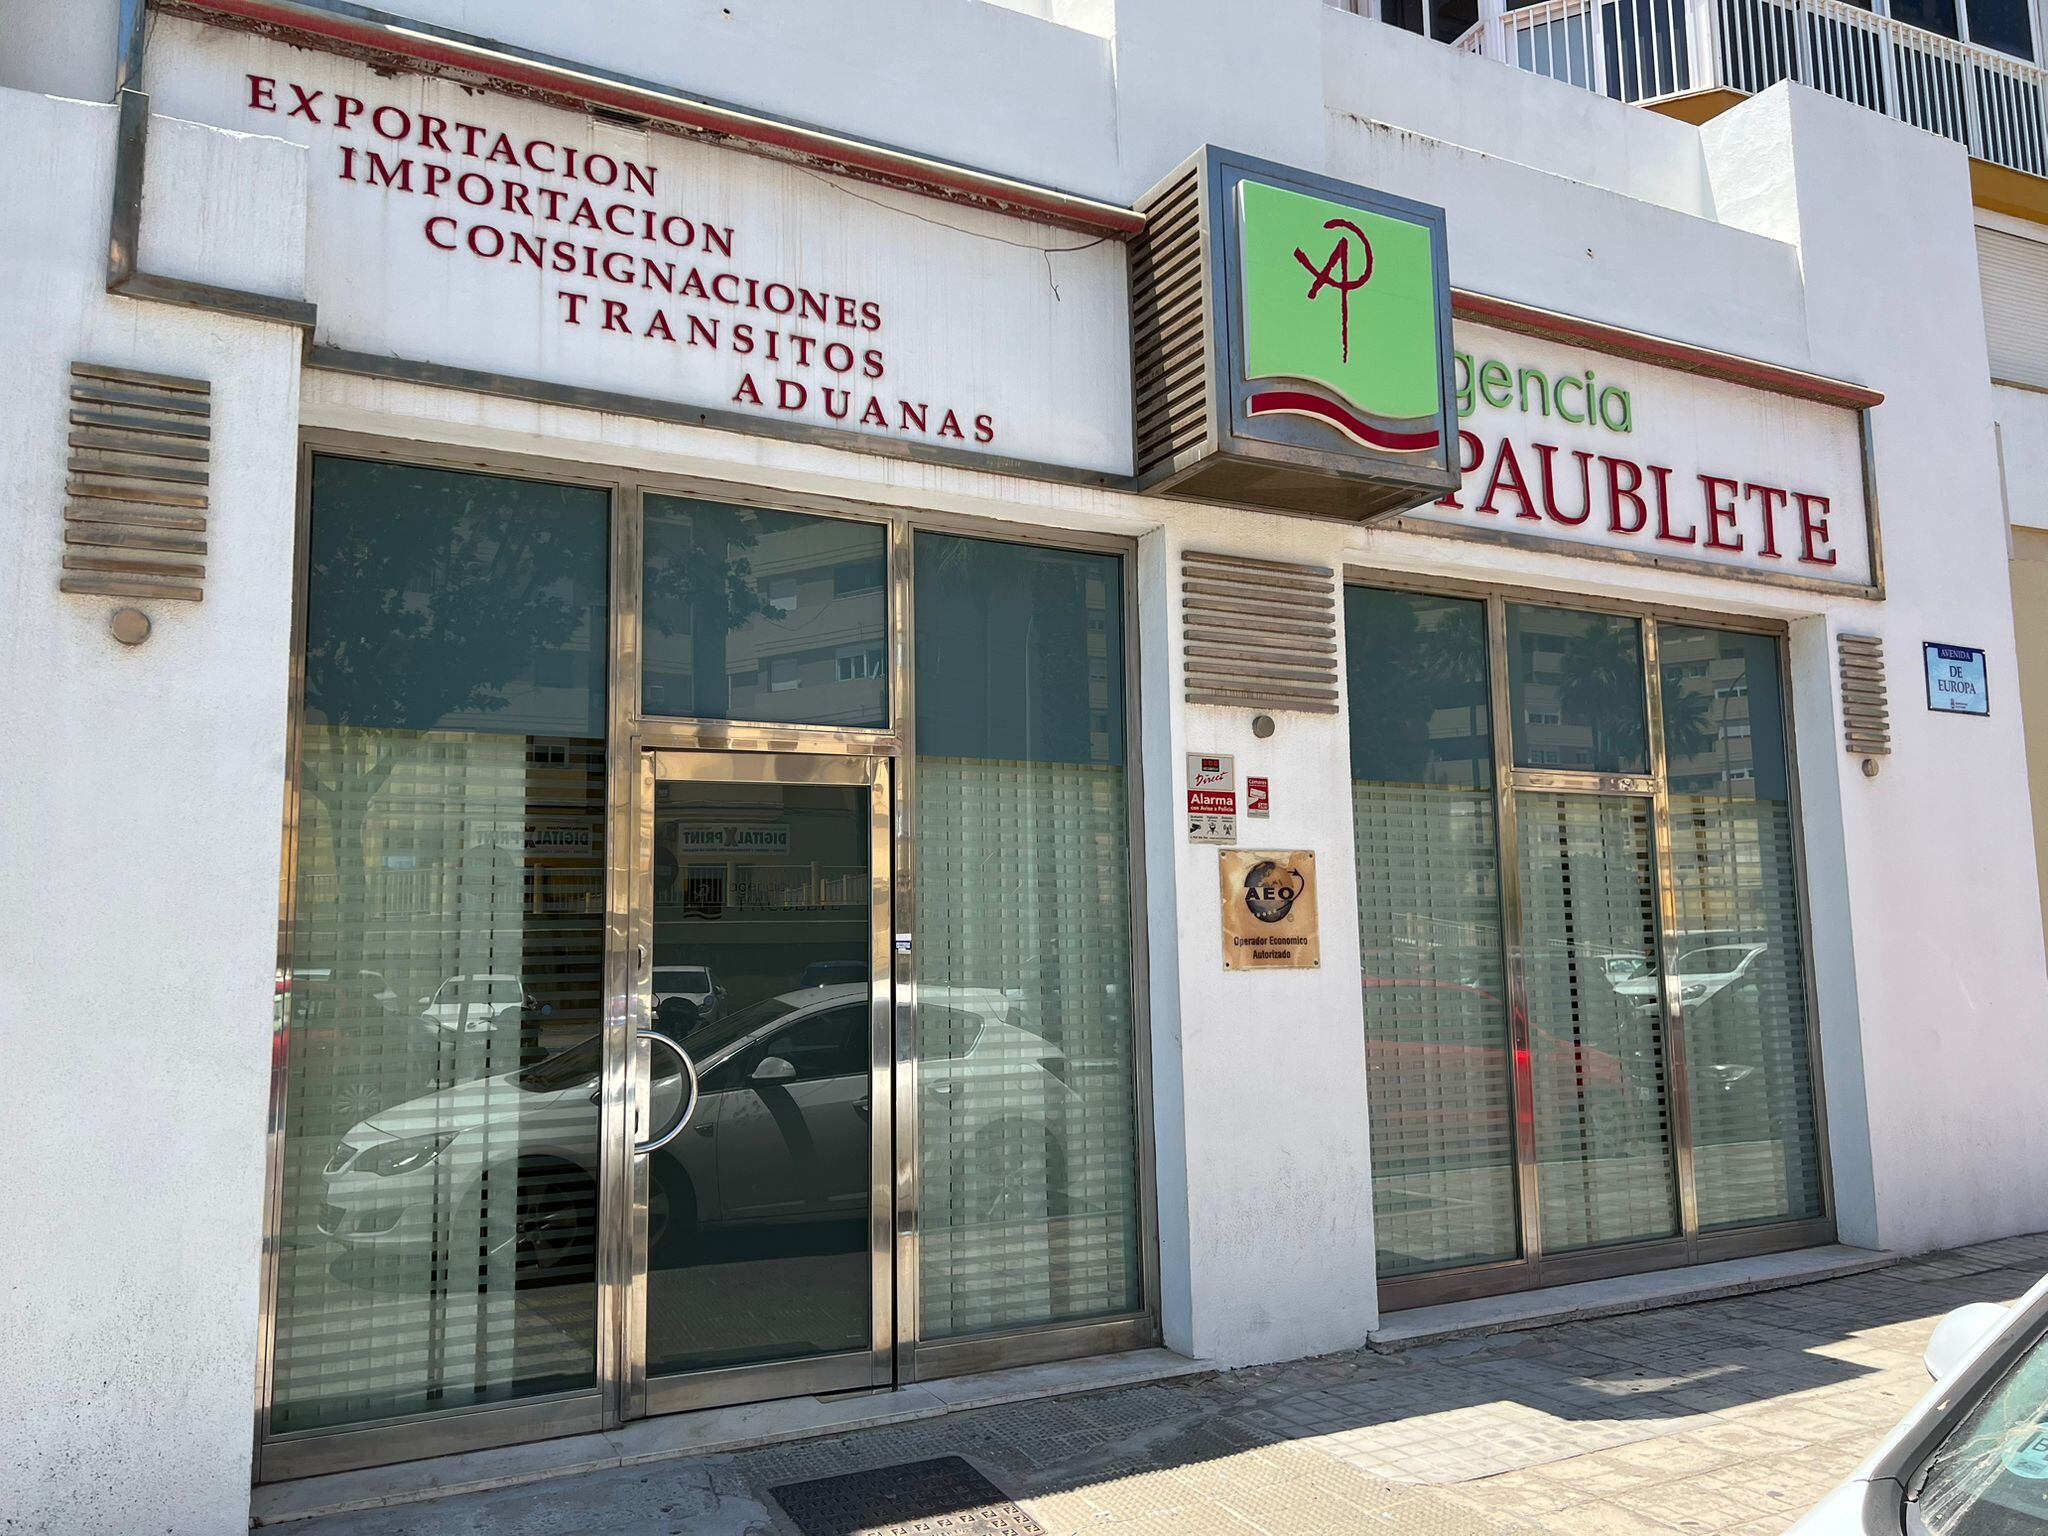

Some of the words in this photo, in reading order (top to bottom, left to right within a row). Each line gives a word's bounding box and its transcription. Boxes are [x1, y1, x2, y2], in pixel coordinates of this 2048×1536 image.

[246, 74, 657, 196] EXPORTACION
[339, 146, 734, 257] IMPORTACION
[425, 217, 881, 331] CONSIGNACIONES
[558, 292, 884, 378] TRANSITOS
[732, 374, 994, 442] ADUANAS
[1456, 350, 1632, 433] gencia
[1434, 430, 1836, 565] PAUBLETE
[1940, 649, 1971, 660] AVENIDA
[1949, 665, 1963, 678] DE
[1938, 679, 1976, 695] EUROPA
[1190, 793, 1233, 806] Alarma
[1245, 887, 1294, 900] AEO
[1234, 937, 1267, 947] Operador
[1253, 950, 1291, 959] Autorizado
